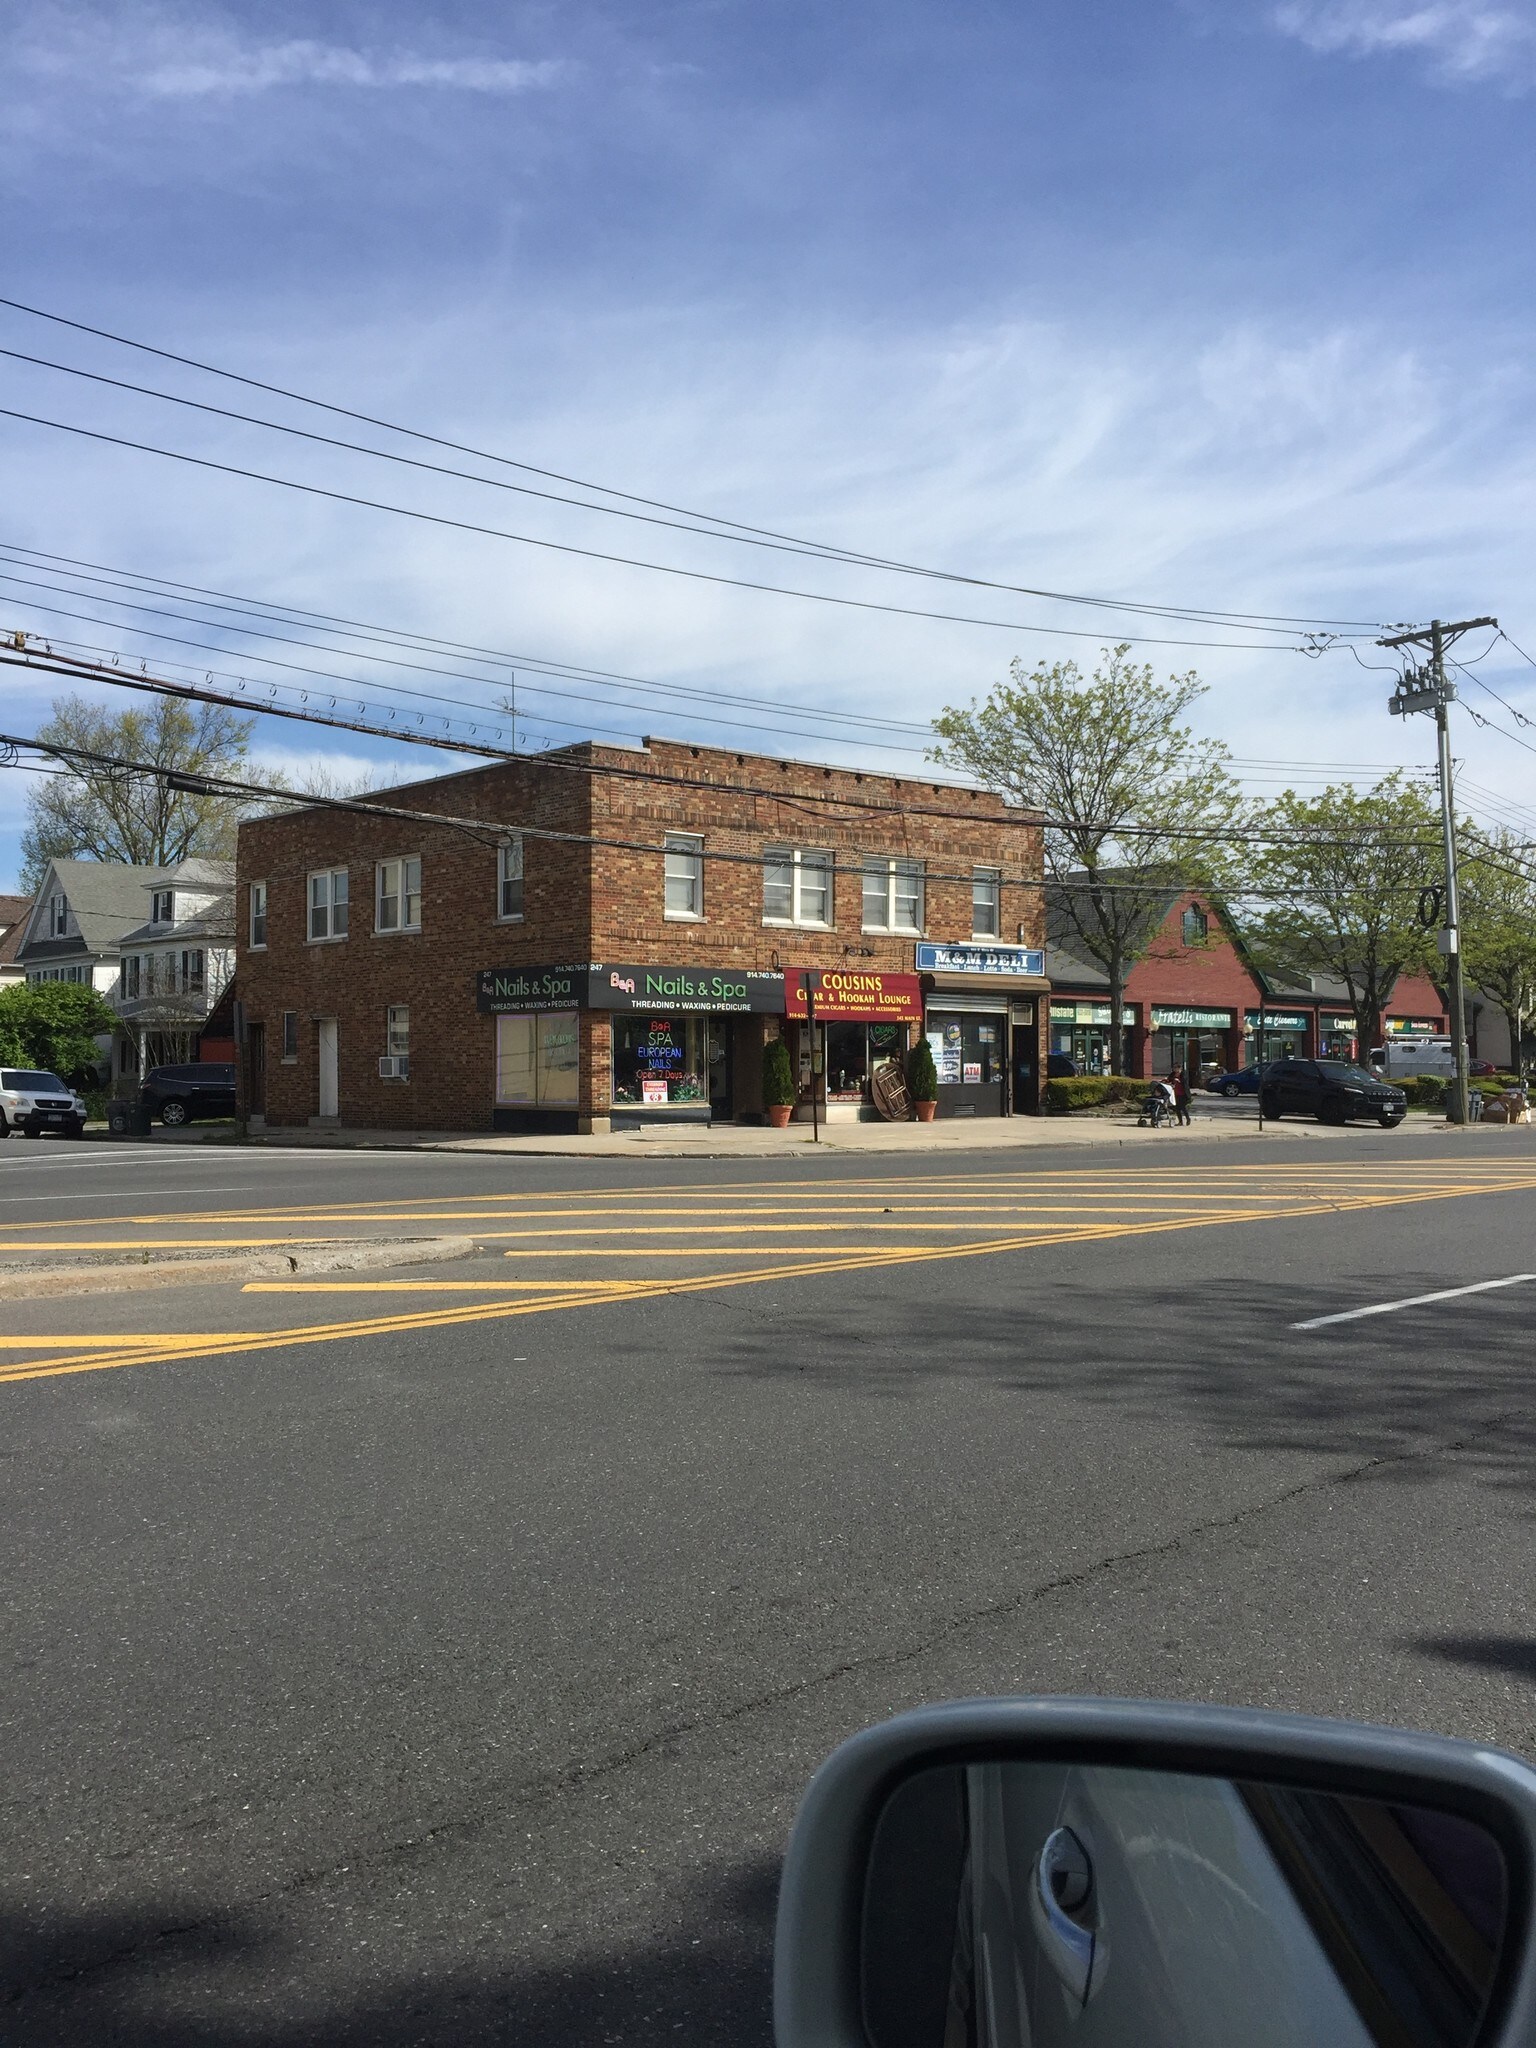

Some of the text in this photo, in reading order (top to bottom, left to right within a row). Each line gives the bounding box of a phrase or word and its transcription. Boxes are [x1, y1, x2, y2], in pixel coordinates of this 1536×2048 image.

[934, 950, 1028, 967] M&M DELI
[495, 976, 530, 996] Nails
[532, 981, 541, 995] &
[542, 975, 571, 998] Spa
[646, 974, 694, 996] Nails
[697, 981, 708, 996] &
[711, 977, 747, 1001] Spa
[822, 974, 882, 991] COUSINS
[796, 989, 824, 1001] CIAR
[828, 993, 834, 1002] &
[490, 999, 579, 1010] THREADING WAXING PEDICURE
[631, 1000, 752, 1011] THREADING WAXING PEDICURE
[1158, 1008, 1231, 1024] Fratelli RISTORANTE
[648, 1032, 673, 1046] SPA
[637, 1046, 682, 1058] EUROPEAN
[648, 1058, 672, 1069] NAILS
[636, 1069, 656, 1080] Open
[665, 1069, 683, 1080] Days
[964, 1067, 979, 1076] ATM
